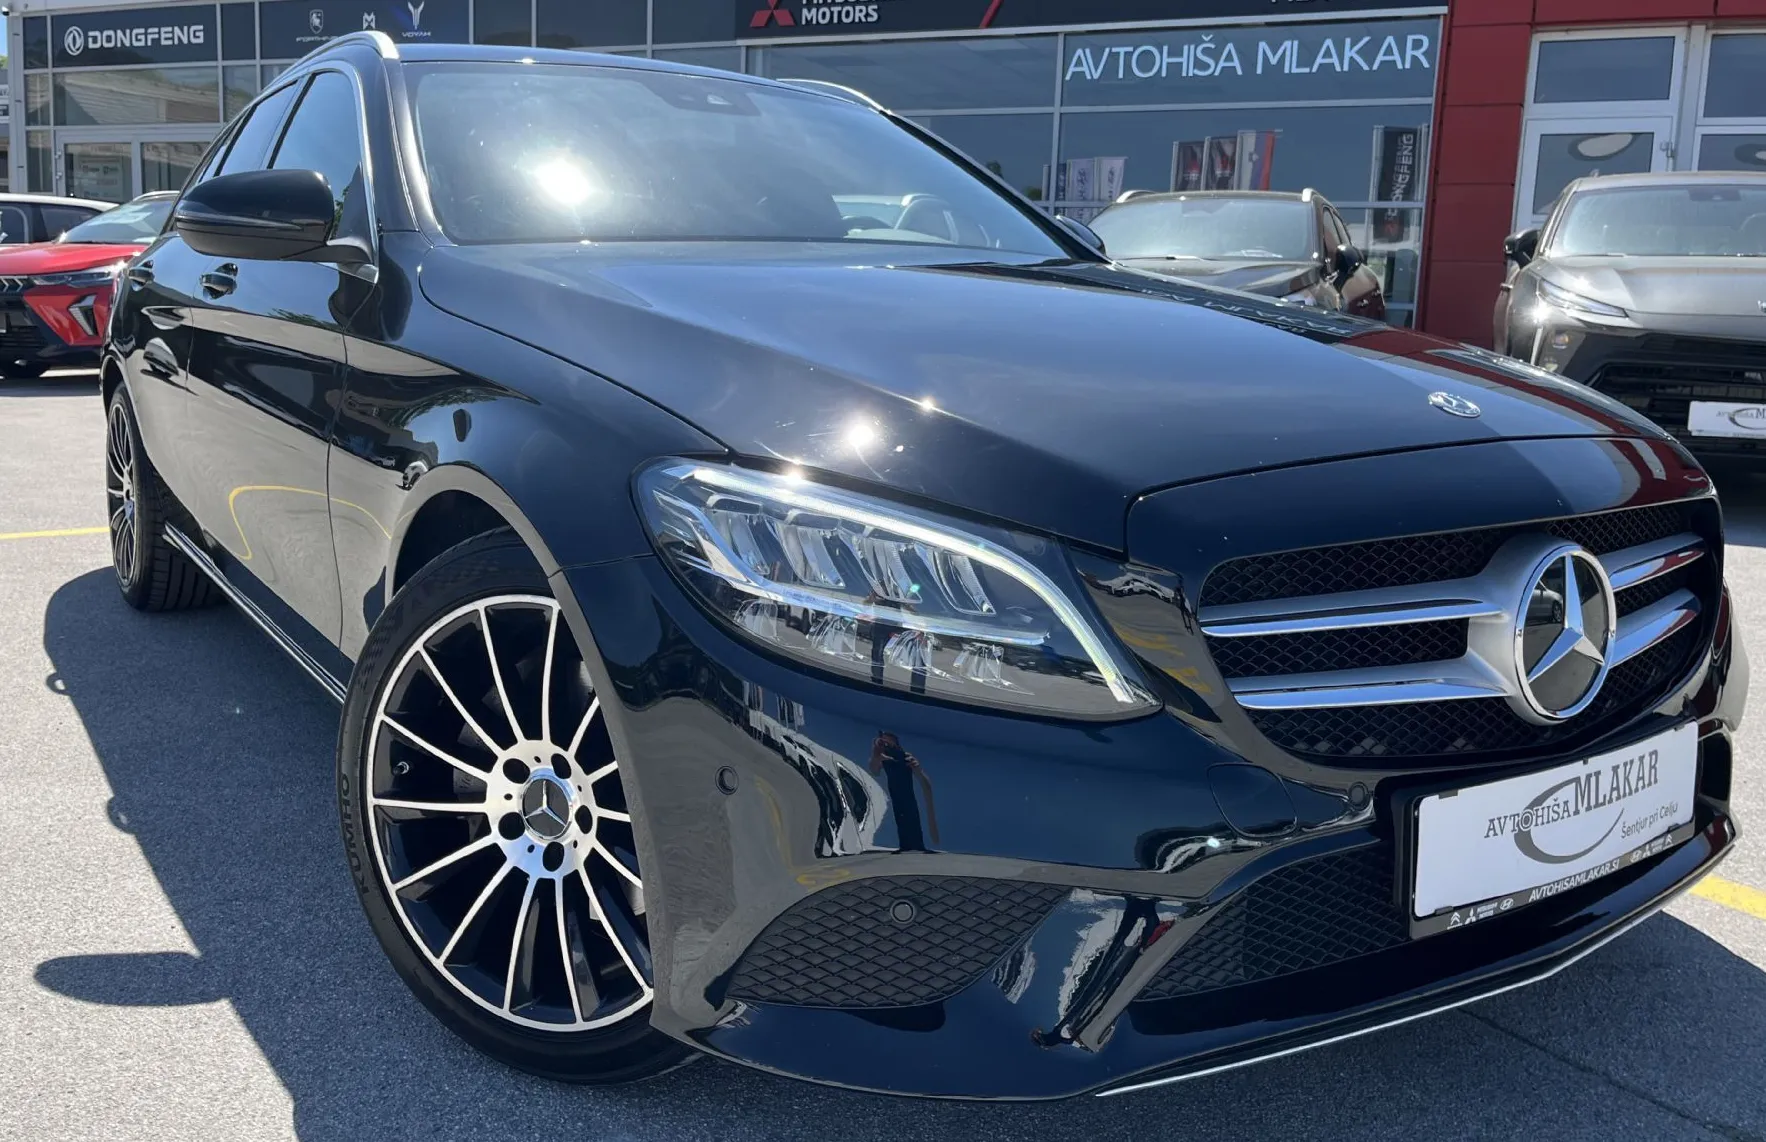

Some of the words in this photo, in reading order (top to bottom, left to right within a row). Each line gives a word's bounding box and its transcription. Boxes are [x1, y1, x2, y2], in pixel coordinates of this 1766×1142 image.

[801, 5, 878, 25] MOTORS
[88, 25, 203, 49] DONGFENG
[1065, 34, 1242, 80] AVTOHIŠA
[1256, 34, 1430, 74] MLAKAR
[1484, 798, 1571, 838] AVTOHIŠA
[1573, 749, 1659, 816] MLAKAR
[1621, 817, 1648, 839] Šentjur
[1648, 808, 1659, 828] pri
[1659, 801, 1678, 819] Celju
